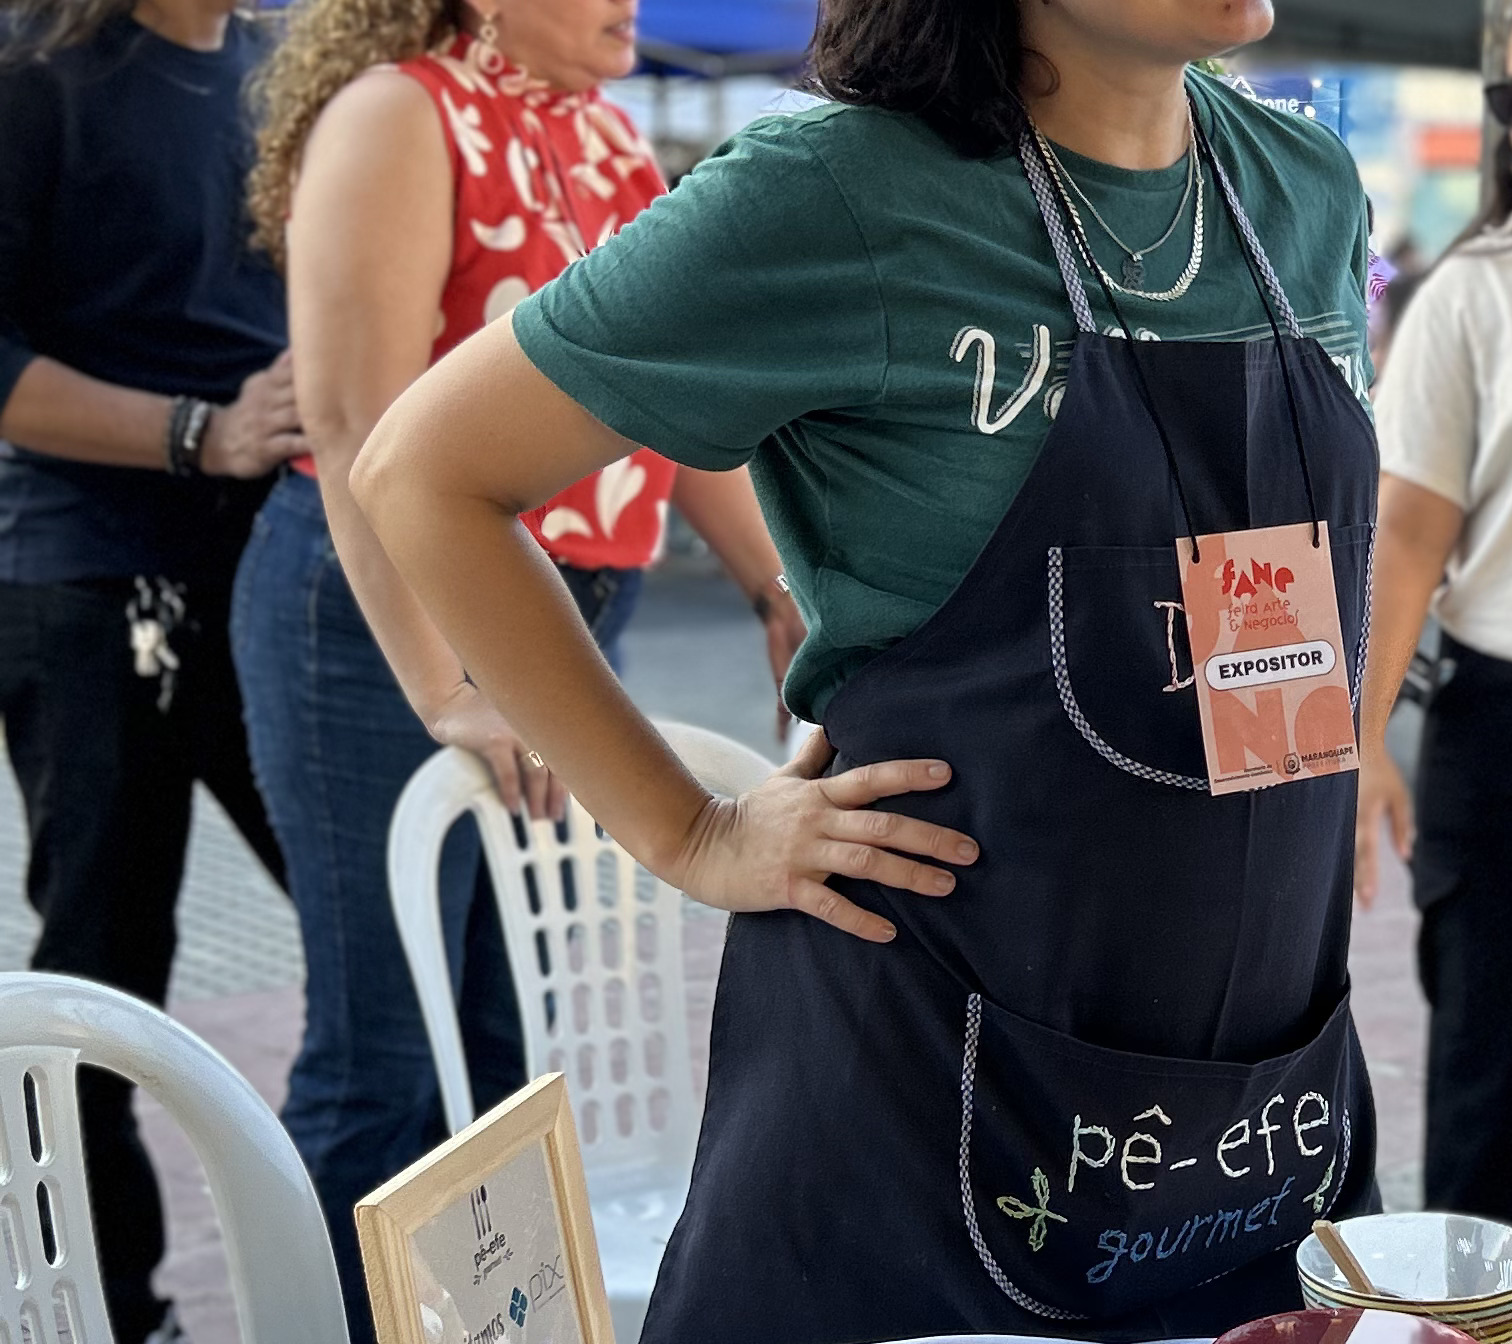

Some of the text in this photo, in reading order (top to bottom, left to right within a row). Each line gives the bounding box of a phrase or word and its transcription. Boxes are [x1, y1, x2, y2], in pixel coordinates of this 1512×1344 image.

[1218, 650, 1324, 680] EXPOSITOR
[1067, 1090, 1330, 1193] pê-efe
[1086, 1176, 1296, 1284] gourmet
